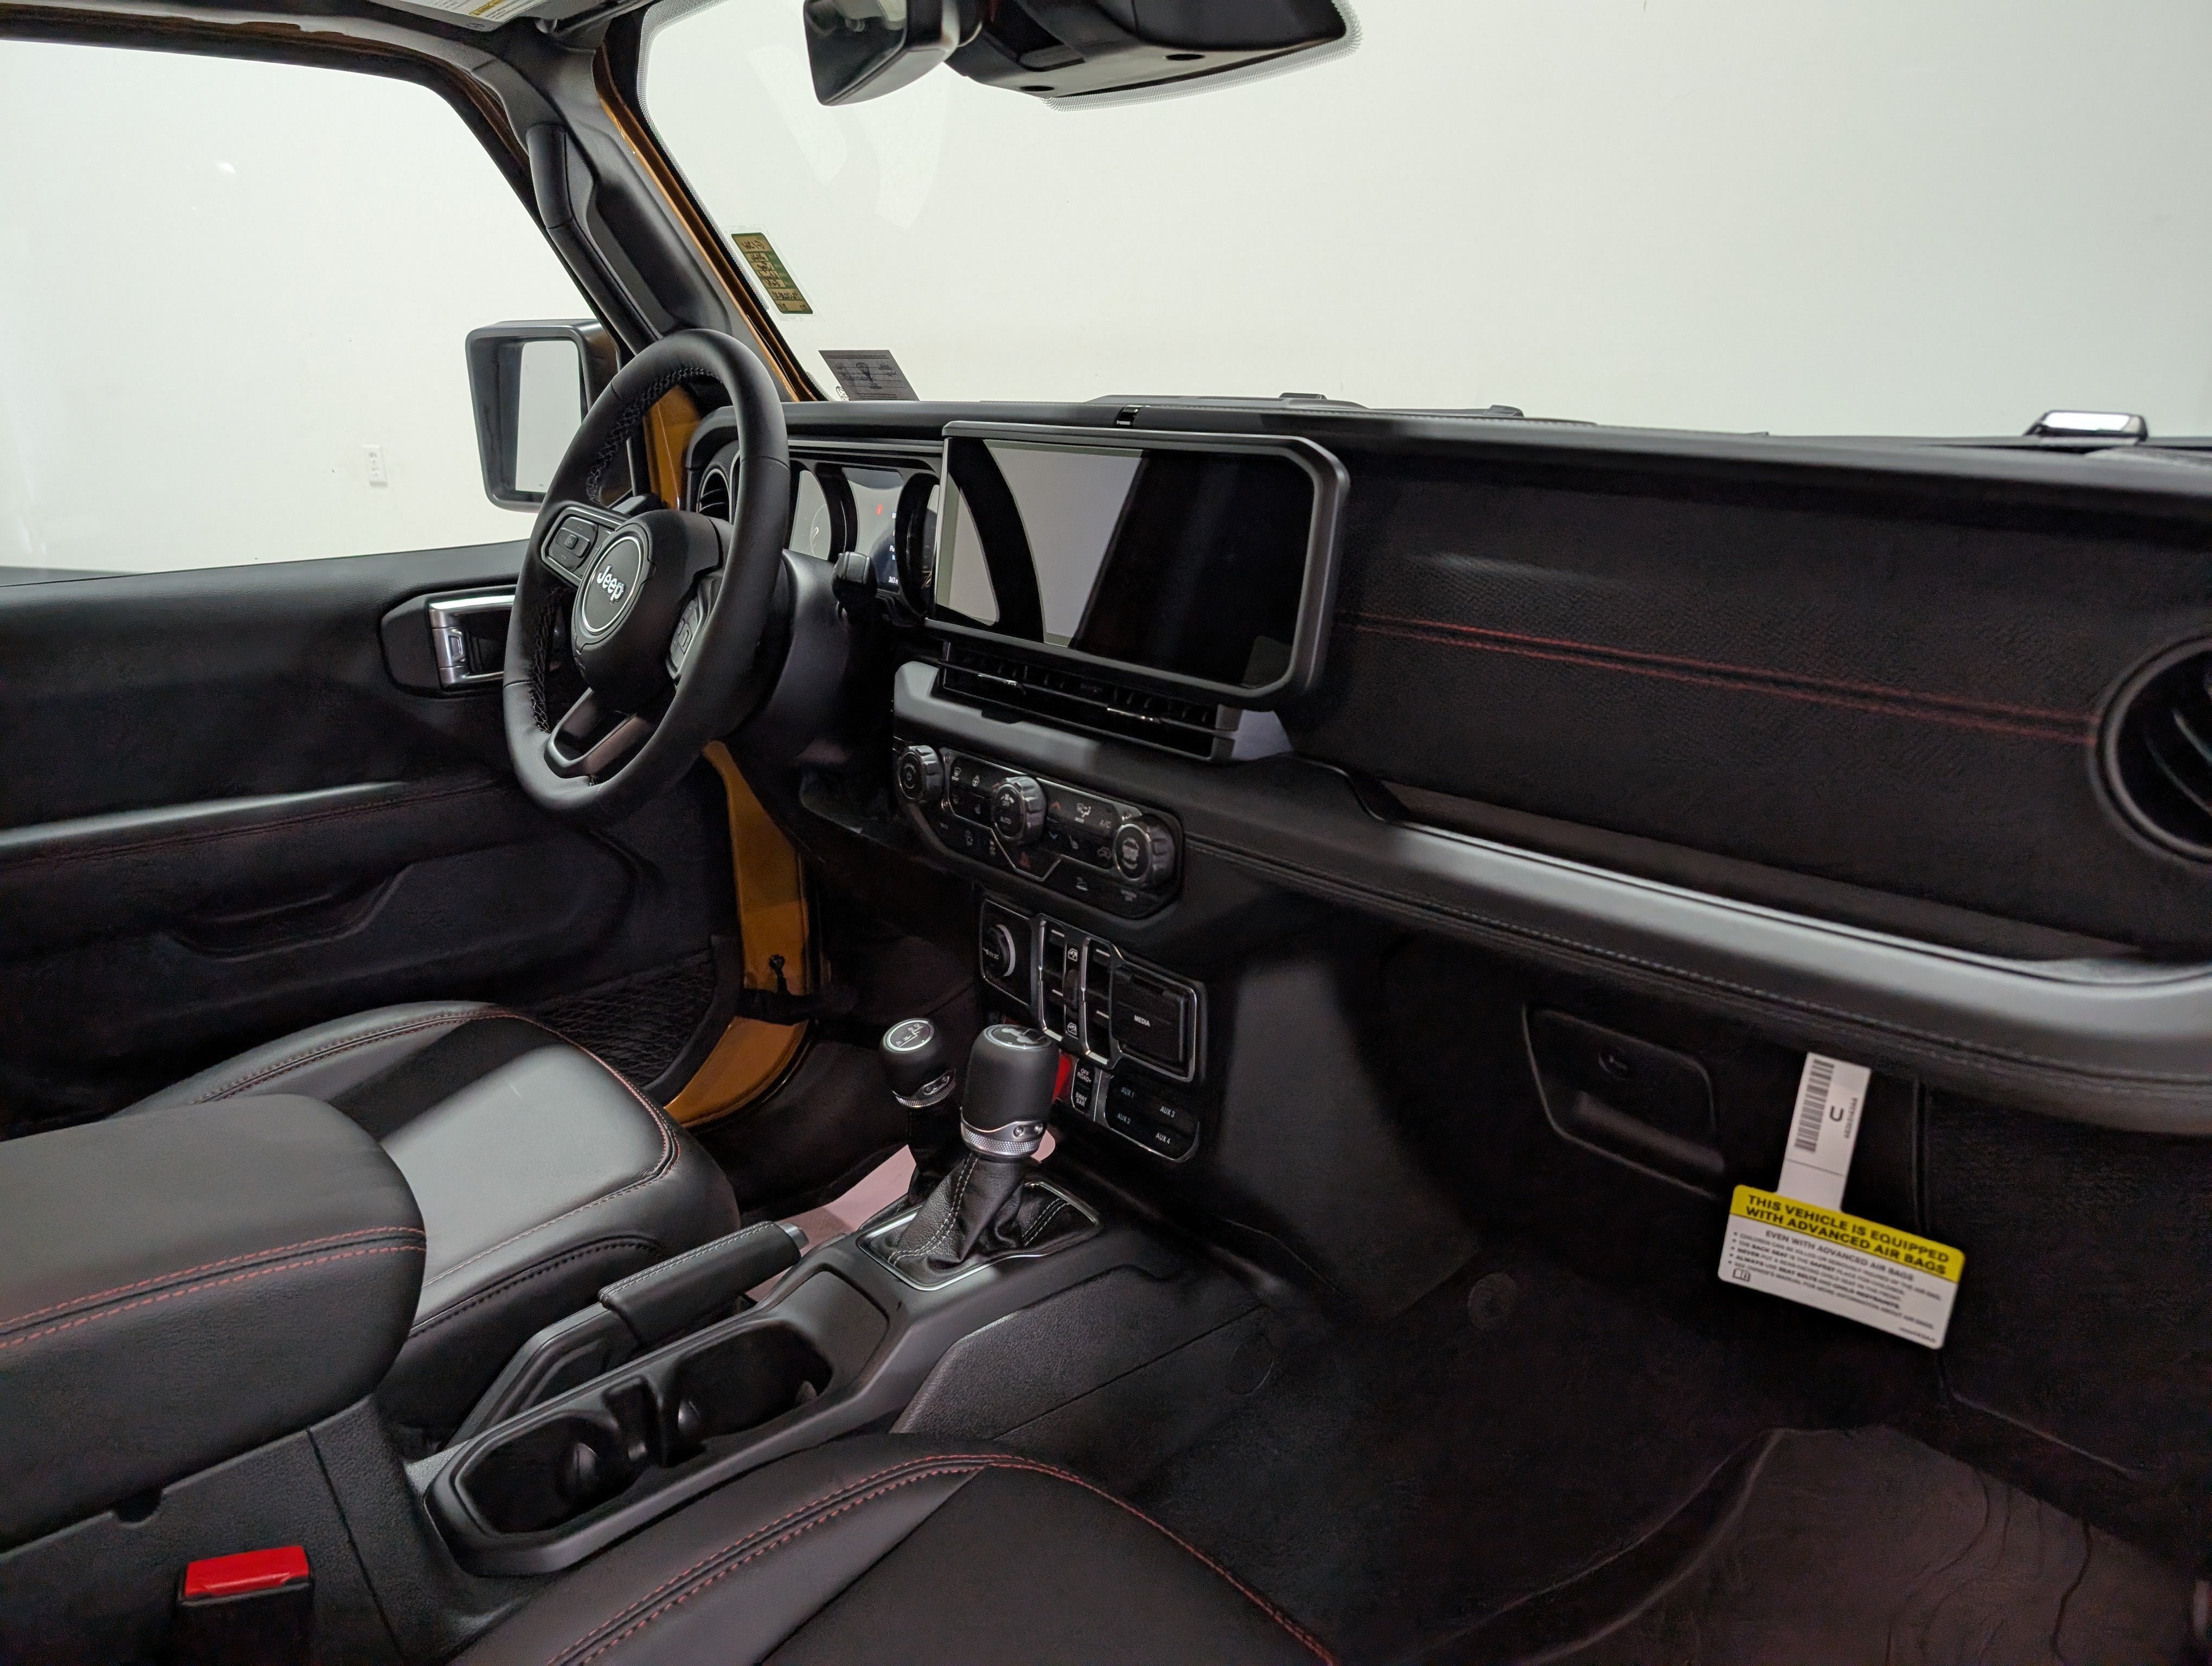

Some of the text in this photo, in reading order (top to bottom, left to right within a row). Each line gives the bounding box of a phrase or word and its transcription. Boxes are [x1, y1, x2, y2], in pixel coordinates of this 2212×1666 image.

[597, 565, 625, 601] Jeep
[1134, 1015, 1151, 1027] MEDIA
[1121, 1087, 1131, 1097] AUX
[1160, 1106, 1170, 1116] AUX
[1117, 1113, 1127, 1123] AUX
[1156, 1132, 1166, 1143] AUX
[1749, 1195, 1949, 1263] THIS VEHICLE IS EQUIPPED
[1746, 1206, 1945, 1274] WITH ADVANCED AIR BAGS
[1766, 1231, 1913, 1281] EVEN WITH ADVANCED AIR BAGS
